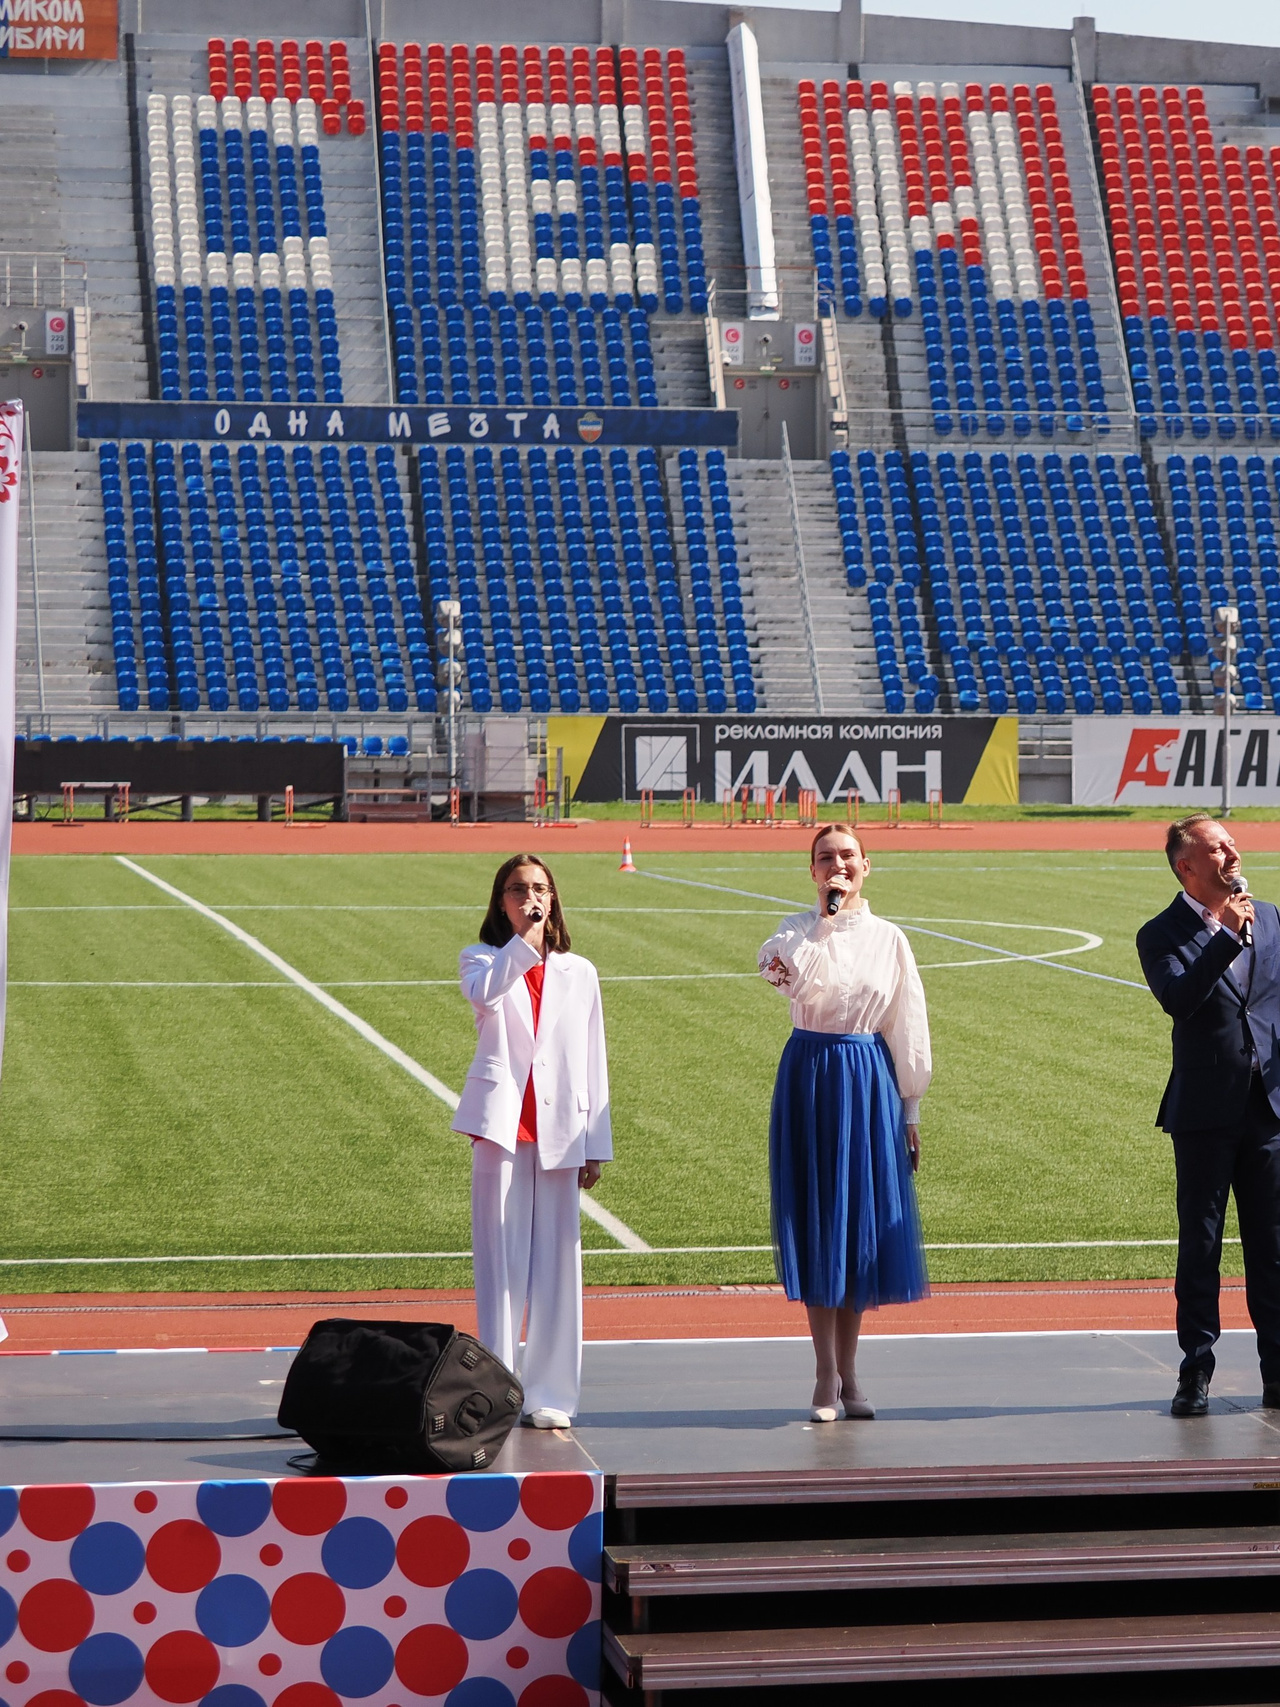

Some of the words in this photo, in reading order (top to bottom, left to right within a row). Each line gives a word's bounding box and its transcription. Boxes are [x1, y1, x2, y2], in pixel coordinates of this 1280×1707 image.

[214, 408, 344, 438] ОДНА
[715, 724, 834, 743] рекламная
[839, 724, 943, 740] компания
[715, 750, 942, 803] ИЛАН
